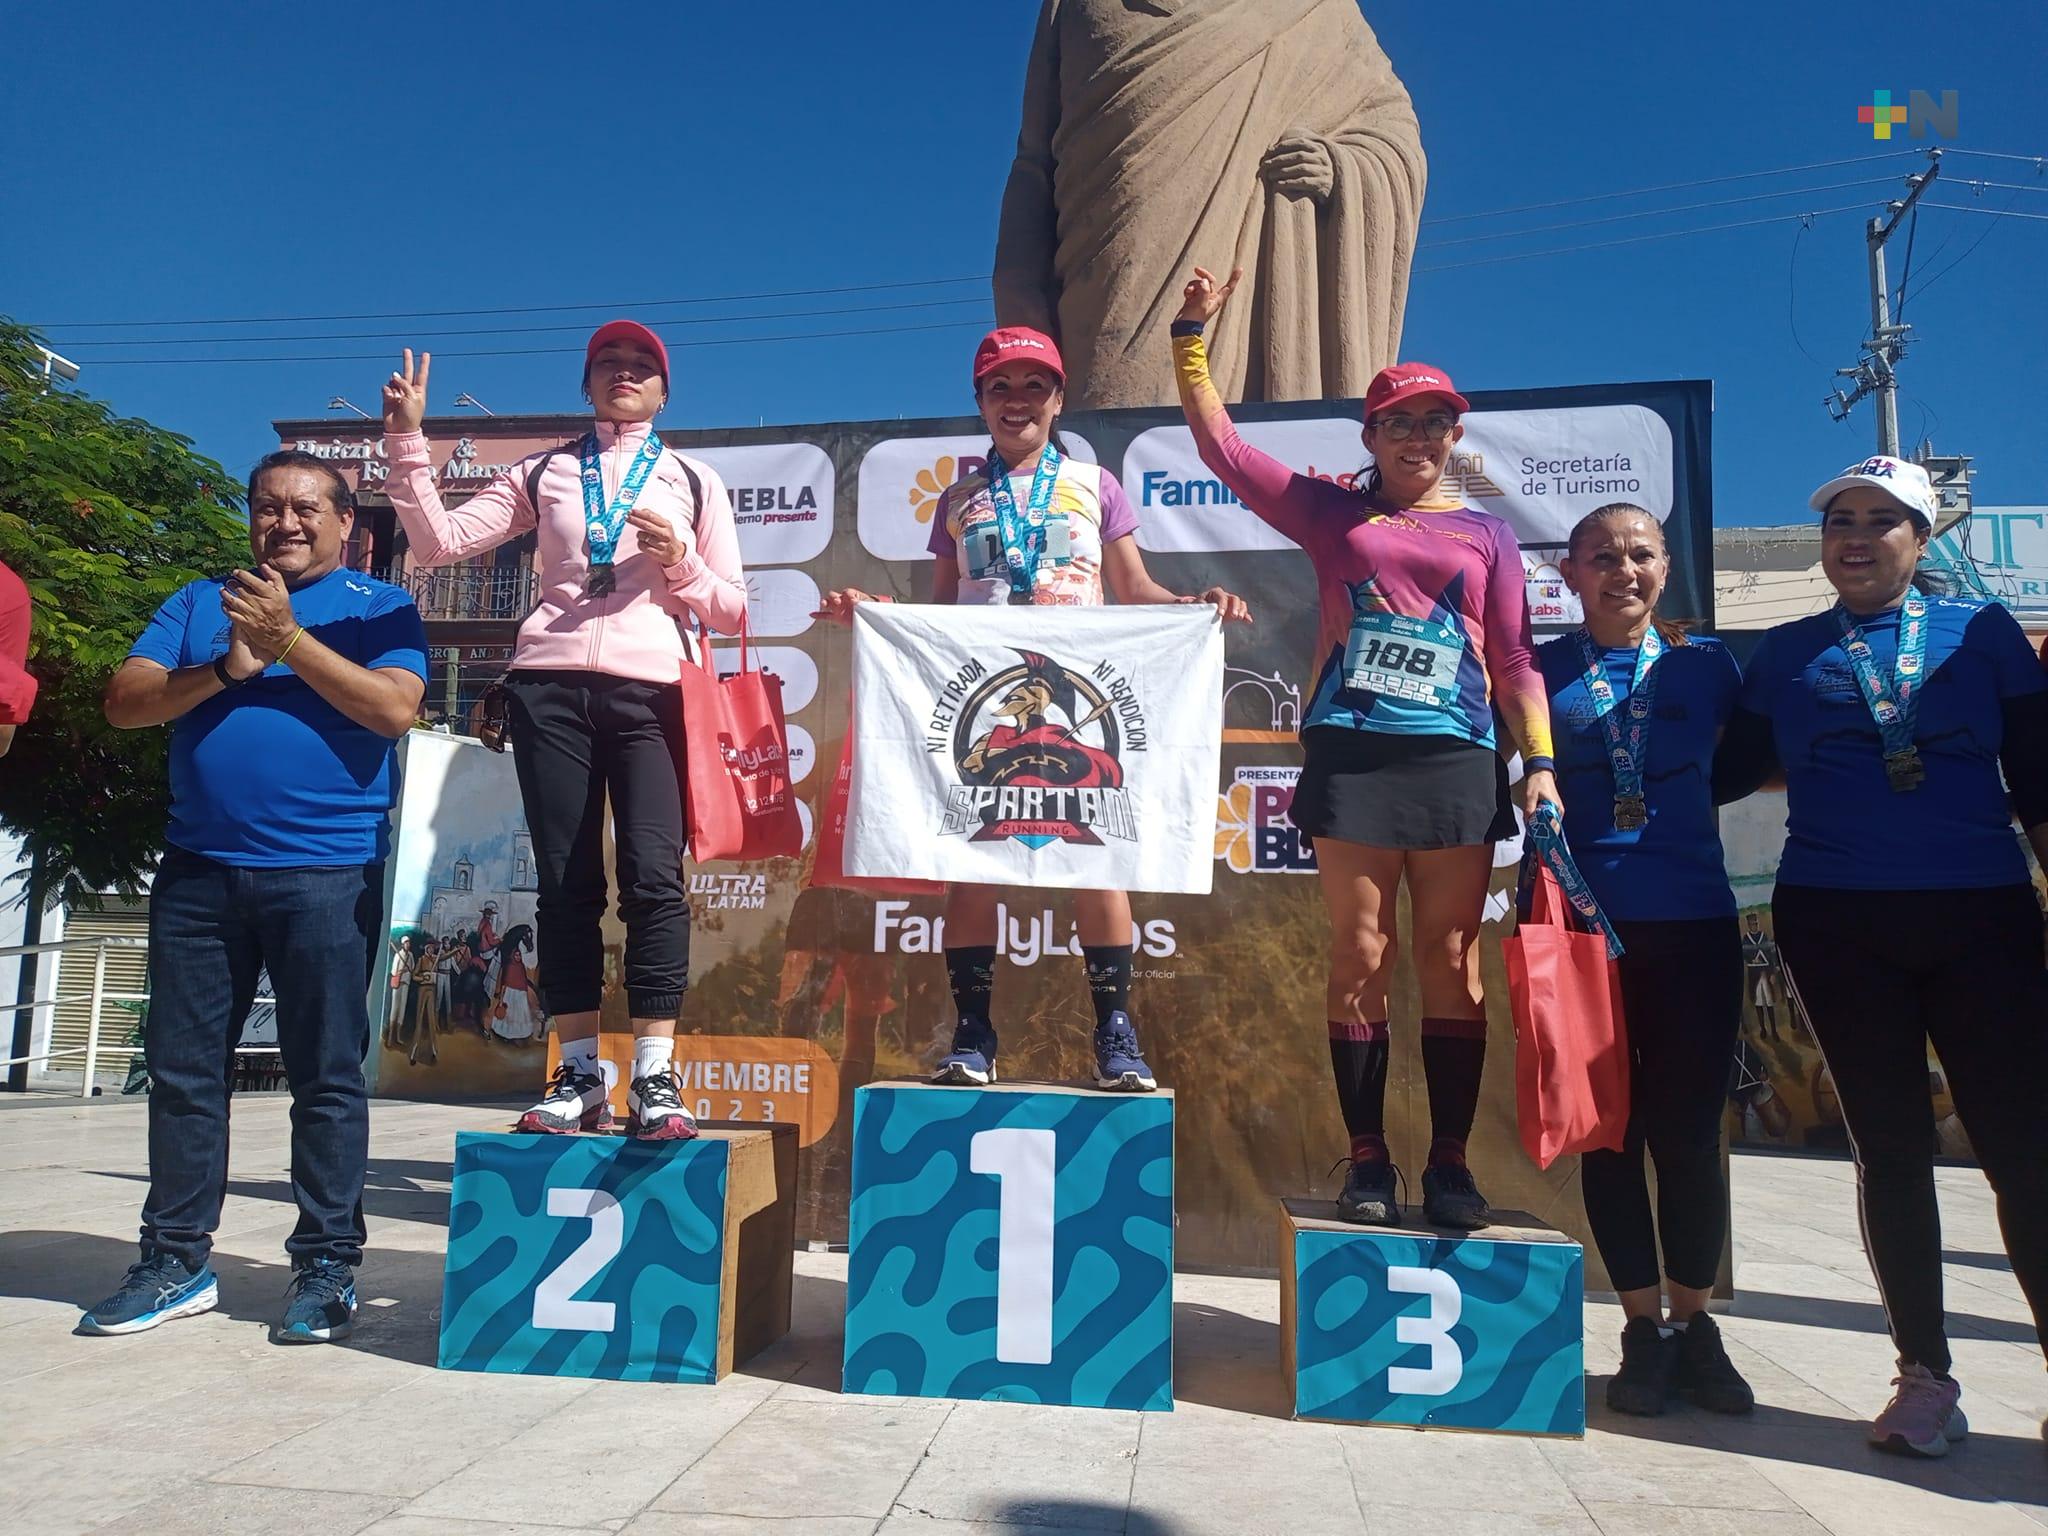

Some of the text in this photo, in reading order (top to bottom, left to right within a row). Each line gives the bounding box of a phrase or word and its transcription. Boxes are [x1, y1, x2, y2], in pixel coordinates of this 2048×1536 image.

[1521, 453, 1632, 475] Secretaría
[1521, 475, 1640, 496] de Turismo
[763, 510, 817, 525] presente
[927, 658, 987, 753] NI RETIRADA
[1092, 659, 1147, 752] NI RENDICION
[937, 784, 1138, 842] SPARTAN
[1002, 824, 1070, 836] RUNNING
[689, 874, 766, 895] ULTRA
[706, 896, 766, 910] LATAM
[1144, 969, 1176, 979] Oficial
[970, 1127, 1056, 1366] 1
[532, 1188, 624, 1332] 2
[1387, 1265, 1463, 1396] 3
